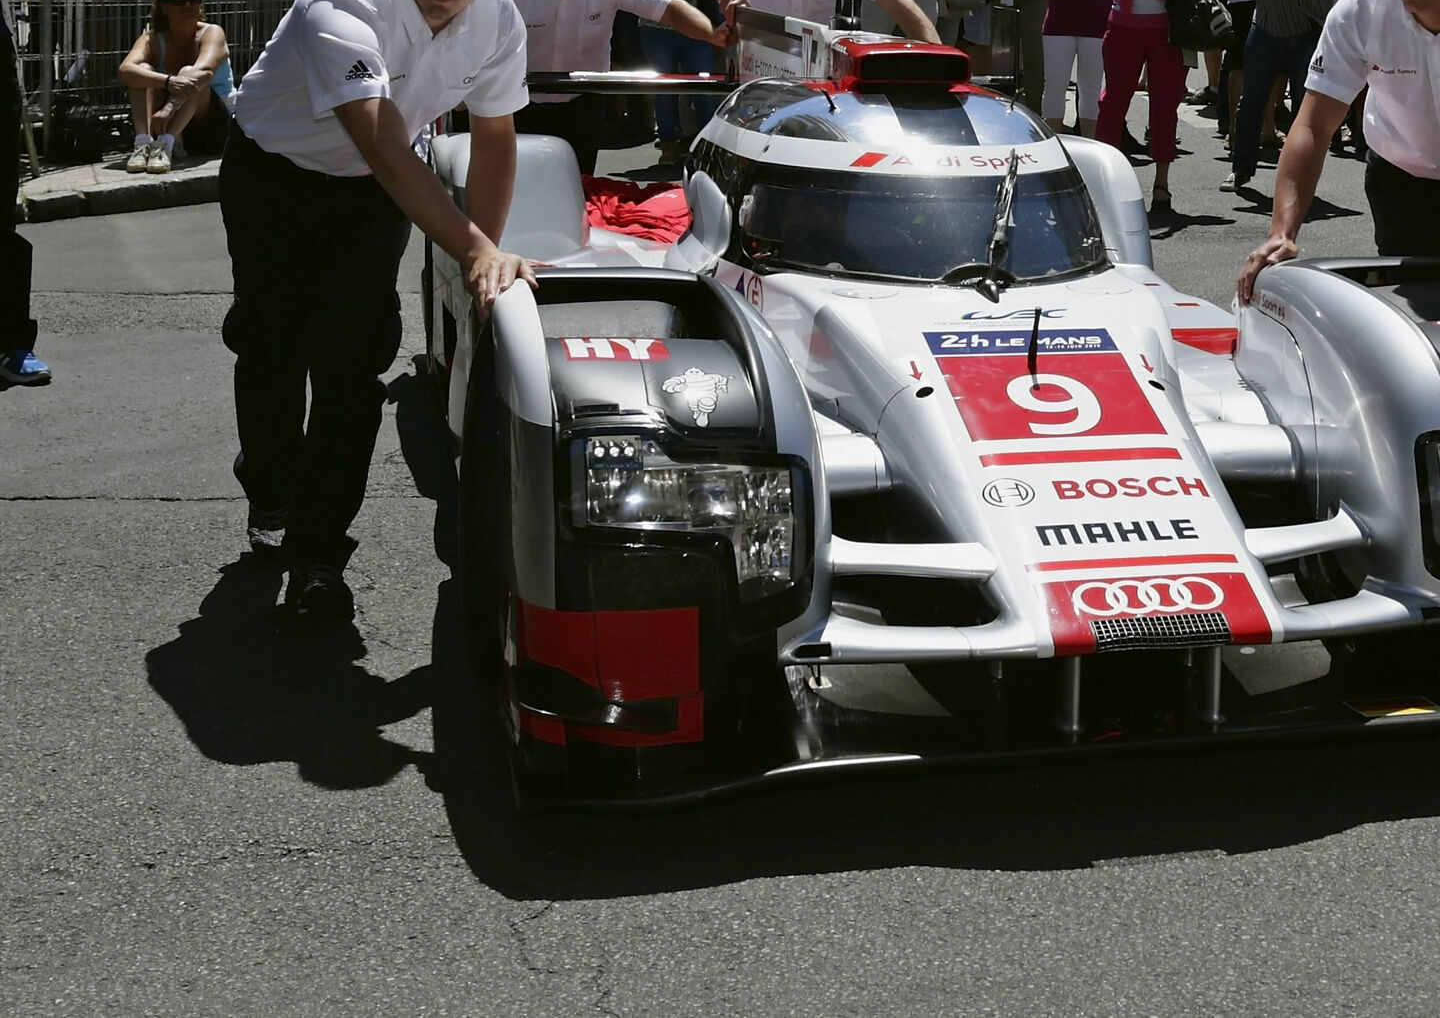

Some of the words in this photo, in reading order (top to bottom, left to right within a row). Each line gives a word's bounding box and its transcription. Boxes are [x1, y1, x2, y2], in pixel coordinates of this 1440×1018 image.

[891, 154, 961, 168] Adi
[564, 338, 655, 360] HY
[995, 337, 1025, 347] LE
[1005, 373, 1103, 437] 9
[1051, 476, 1211, 500] BOSCH
[1035, 519, 1200, 546] MAHLE
